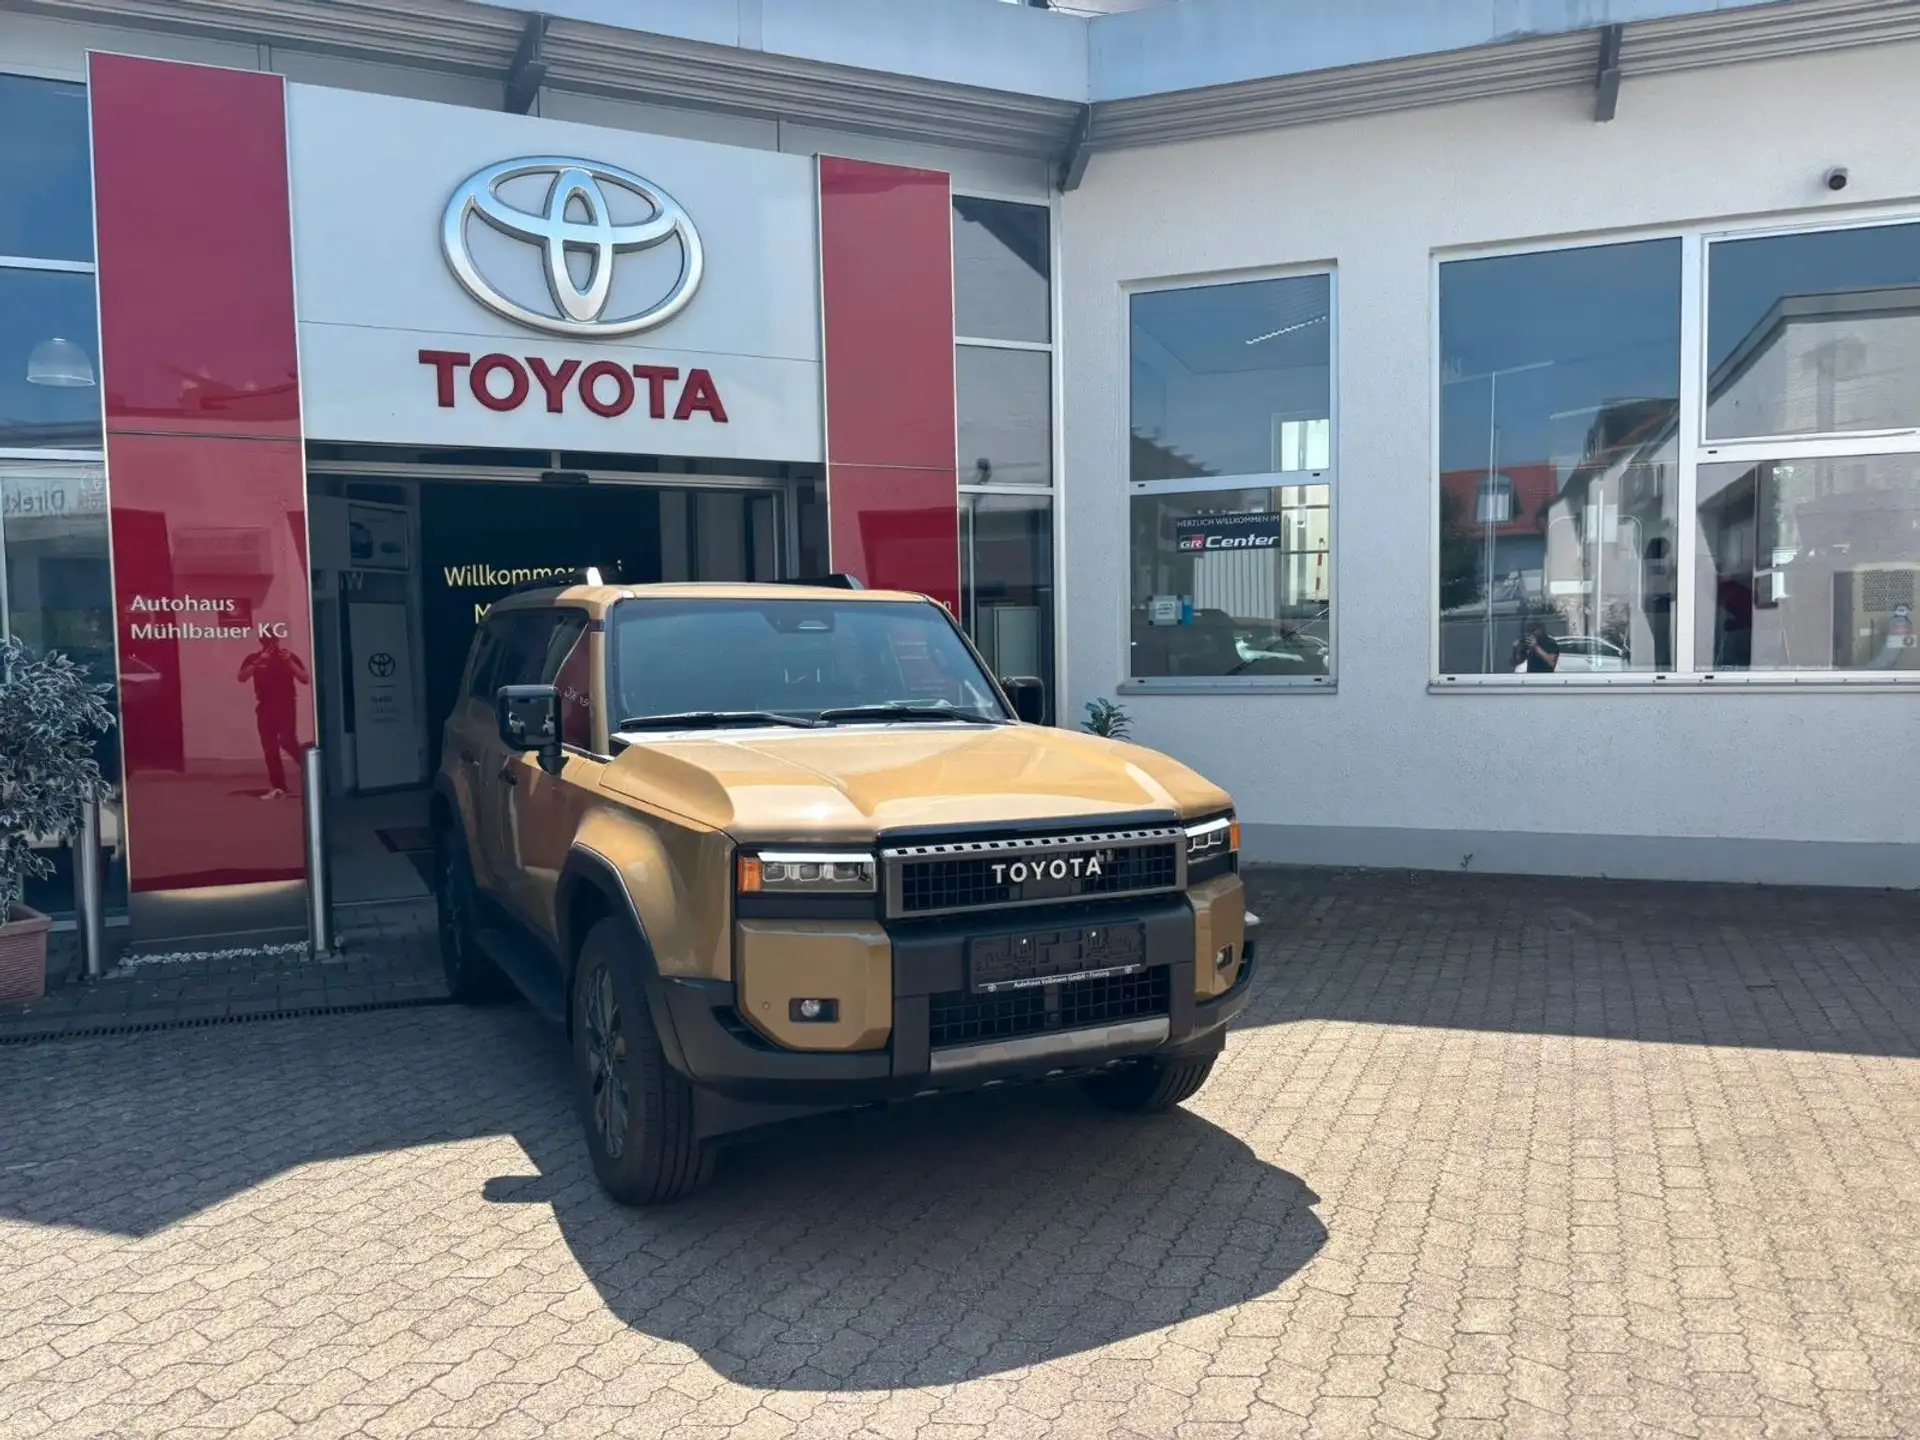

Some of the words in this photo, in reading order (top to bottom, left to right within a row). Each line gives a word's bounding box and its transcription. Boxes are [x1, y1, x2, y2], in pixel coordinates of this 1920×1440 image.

[418, 349, 729, 423] TOYOTA
[1177, 518, 1214, 527] HERZLICH
[1215, 515, 1268, 525] WILLKOMMEN
[1270, 514, 1279, 522] IM
[1180, 540, 1203, 549] GR
[1205, 534, 1279, 549] Center
[444, 564, 576, 587] Willkomm
[130, 595, 235, 611] Autohaus
[130, 623, 250, 640] Mühlbauer
[258, 622, 288, 638] KG
[991, 856, 1102, 884] TOYOTA
